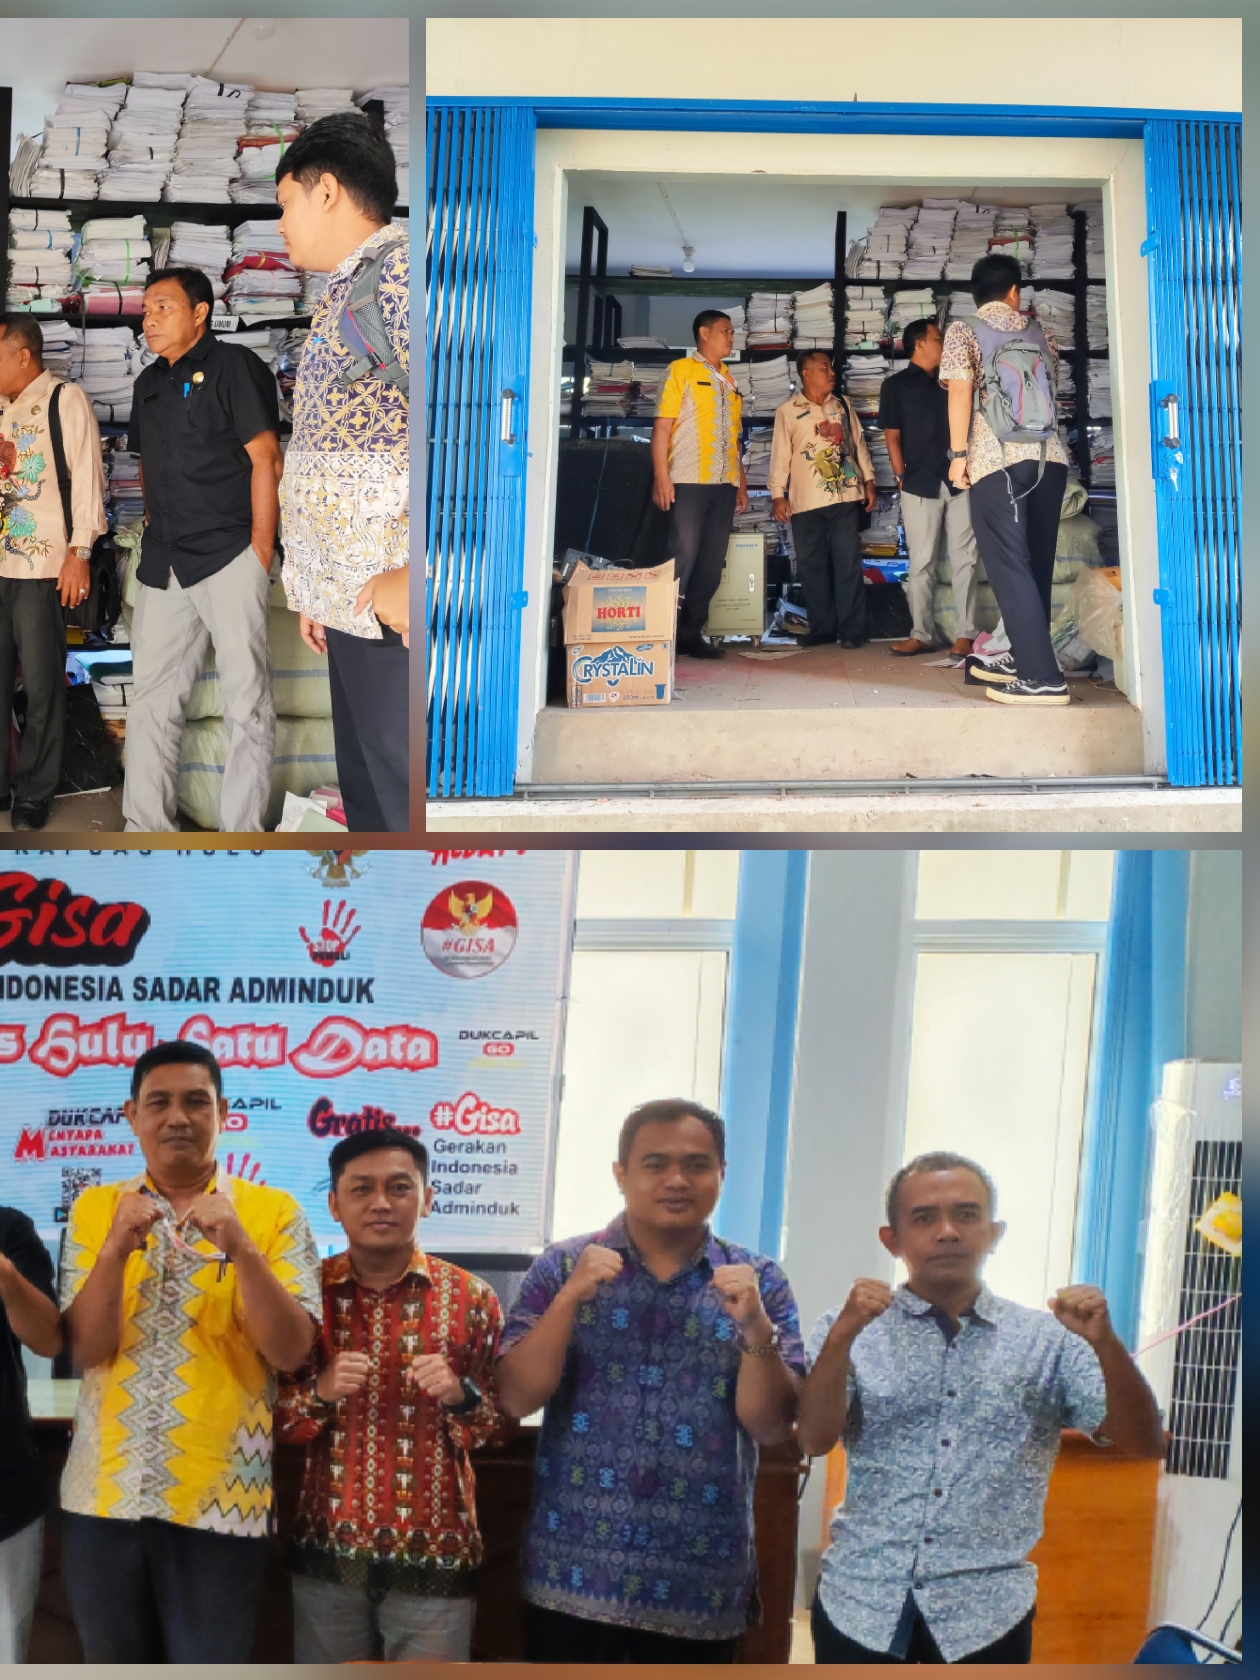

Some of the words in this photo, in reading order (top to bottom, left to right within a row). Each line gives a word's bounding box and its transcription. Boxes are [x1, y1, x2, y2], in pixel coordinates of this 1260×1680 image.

[597, 606, 641, 619] HORTI
[441, 937, 495, 953] #GISA
[132, 976, 222, 1003] SADAR
[228, 977, 375, 1004] ADMINDUK
[458, 1030, 540, 1040] DUKCAPIL
[292, 1017, 435, 1075] Data
[487, 1045, 510, 1054] GO
[432, 1093, 519, 1134] #Gisa
[433, 1138, 506, 1154] Gerakan
[431, 1159, 518, 1174] Indonesia
[431, 1180, 482, 1195] Sadar
[431, 1200, 520, 1215] Adminduk
